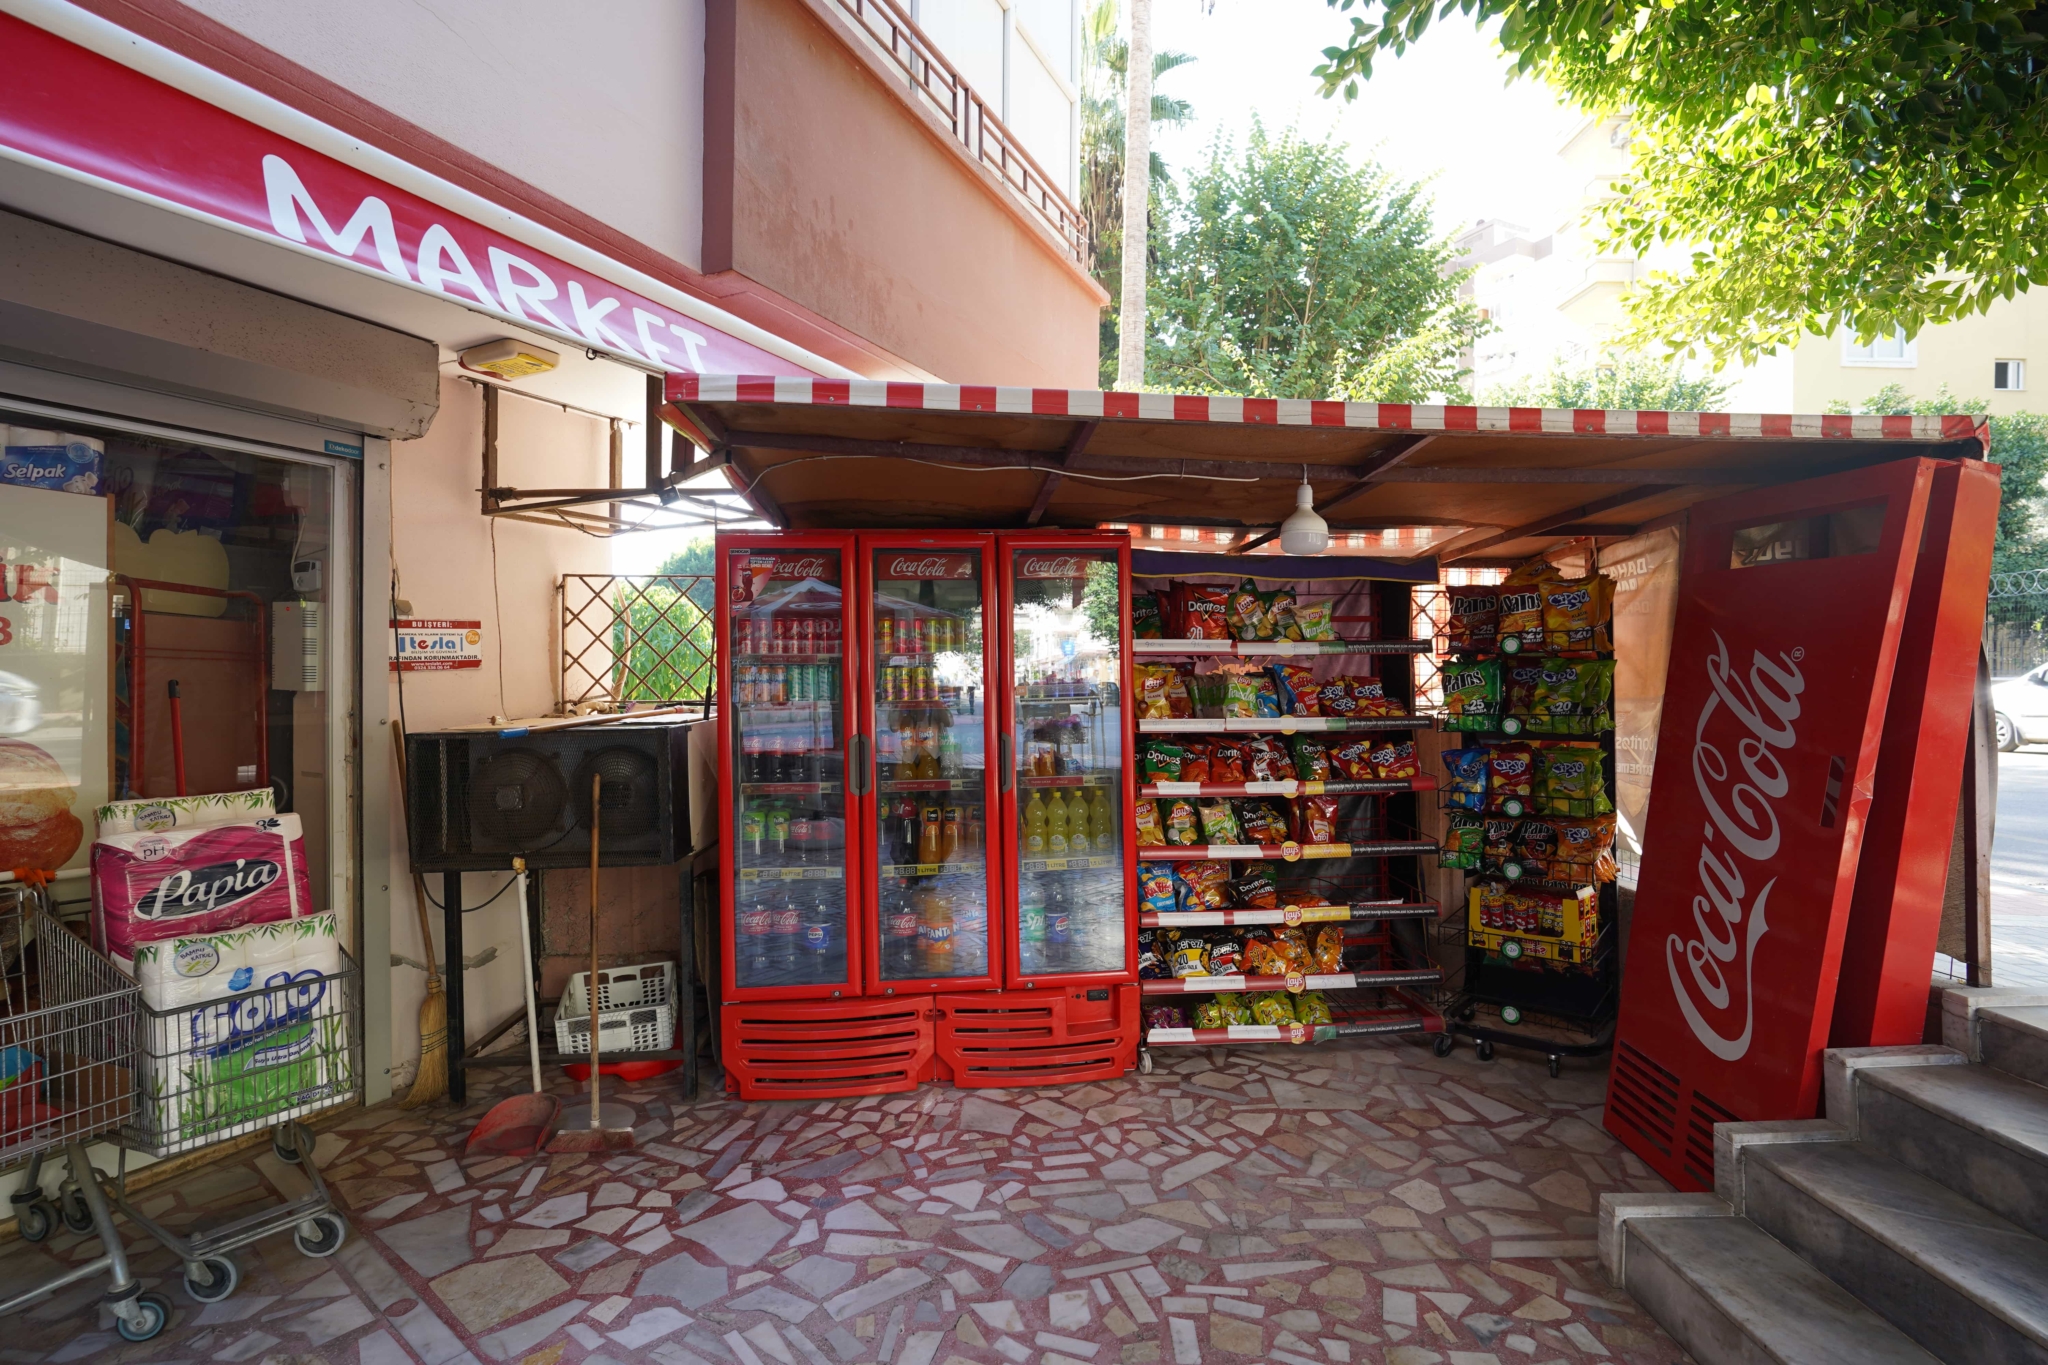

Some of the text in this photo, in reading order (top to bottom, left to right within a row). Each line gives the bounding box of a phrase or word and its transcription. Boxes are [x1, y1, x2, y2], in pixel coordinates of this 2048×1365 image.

[262, 154, 707, 374] MARKET
[4, 464, 66, 481] Selpak
[771, 558, 826, 577] oca-Cola
[890, 557, 948, 577] Coca-Cola
[1024, 557, 1080, 577] Coca-Cola
[1188, 600, 1226, 613] Doritos
[1236, 595, 1255, 613] Lay's
[1274, 598, 1294, 612] Lay's
[1452, 595, 1497, 615] PaTos
[1308, 610, 1324, 620] Lay's
[410, 636, 456, 650] tesla
[1238, 676, 1252, 686] Lay's
[1493, 759, 1526, 772] CiPSO
[1552, 762, 1585, 775] CiPSO
[143, 845, 165, 859] pH
[1283, 846, 1299, 856] Lay's
[1667, 629, 1806, 1061] Coca-Cola
[149, 859, 279, 919] Papia
[1239, 878, 1272, 892] Doritos
[1285, 910, 1301, 920] Lay's
[927, 926, 951, 938] FANTA
[180, 947, 205, 960] BAMBU
[1286, 978, 1303, 987] Lay's
